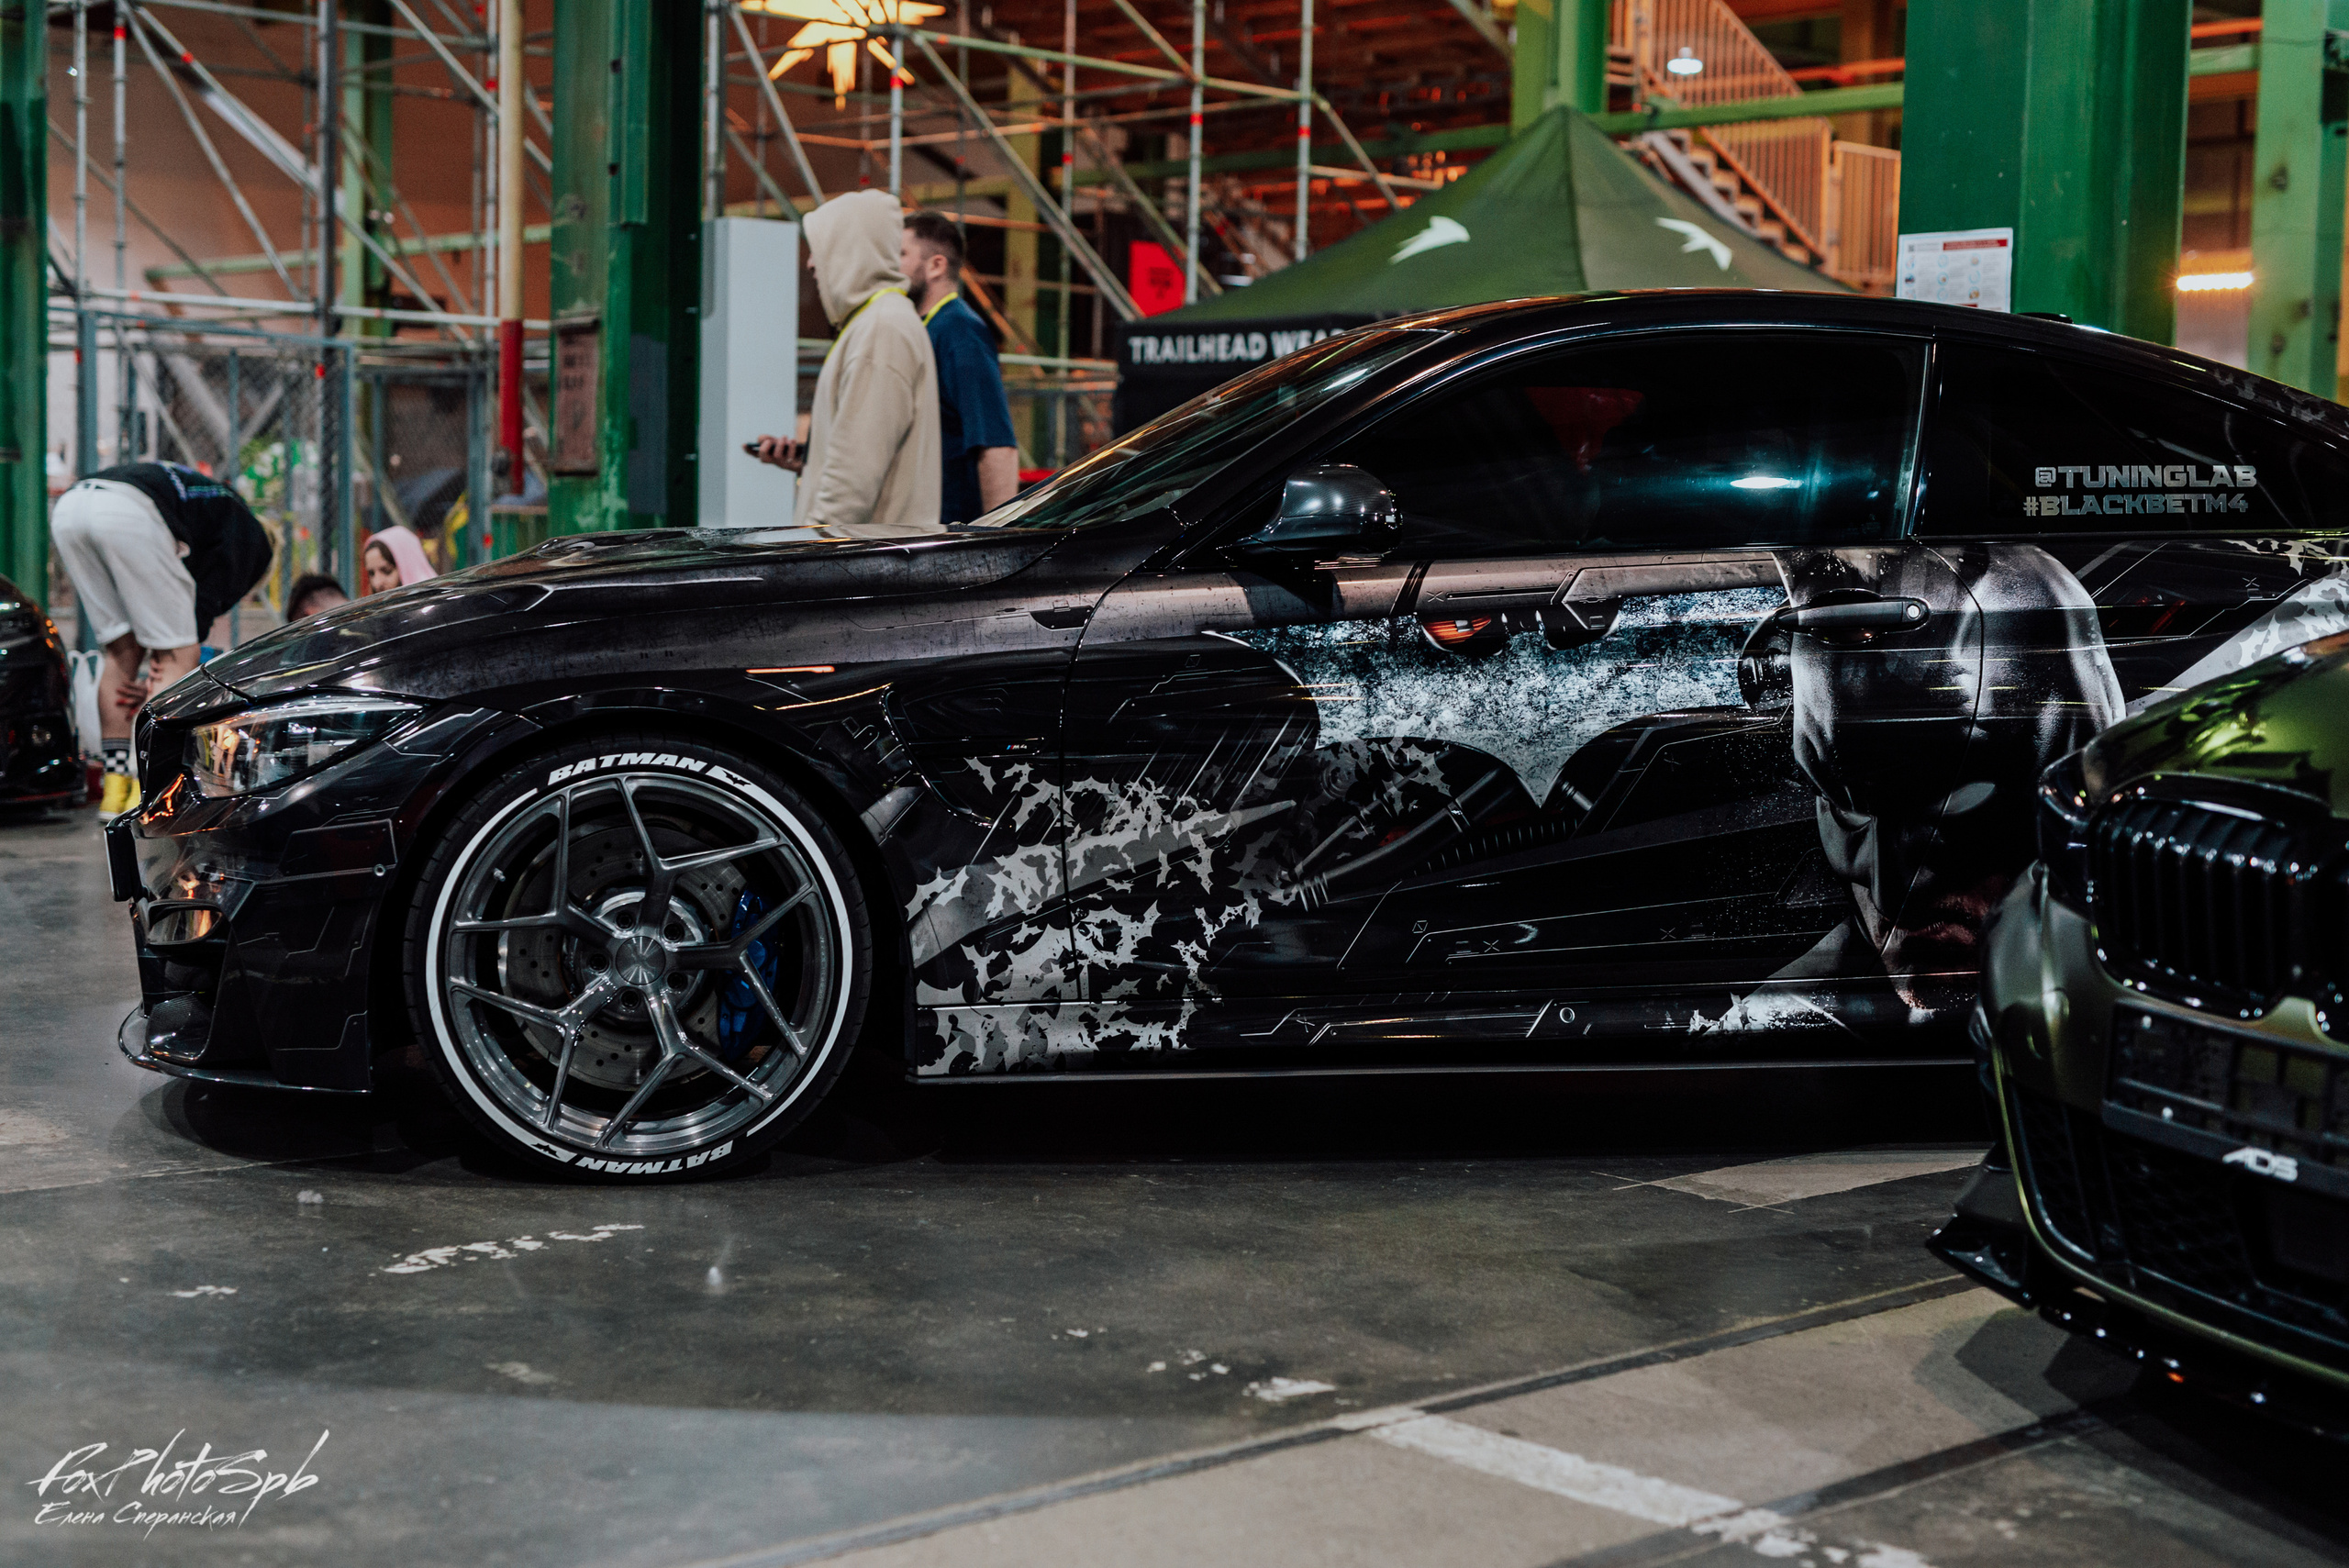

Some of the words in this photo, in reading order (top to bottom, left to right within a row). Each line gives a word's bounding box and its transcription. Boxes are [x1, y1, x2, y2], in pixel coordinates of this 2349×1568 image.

[1128, 331, 1267, 363] TRAILHEAD
[1270, 328, 1346, 359] WE
[2034, 465, 2257, 489] @TUNINGLAB
[2023, 494, 2249, 517] #BLACKBETM4
[548, 752, 708, 785] BATMAN
[574, 1140, 734, 1174] BATMAN
